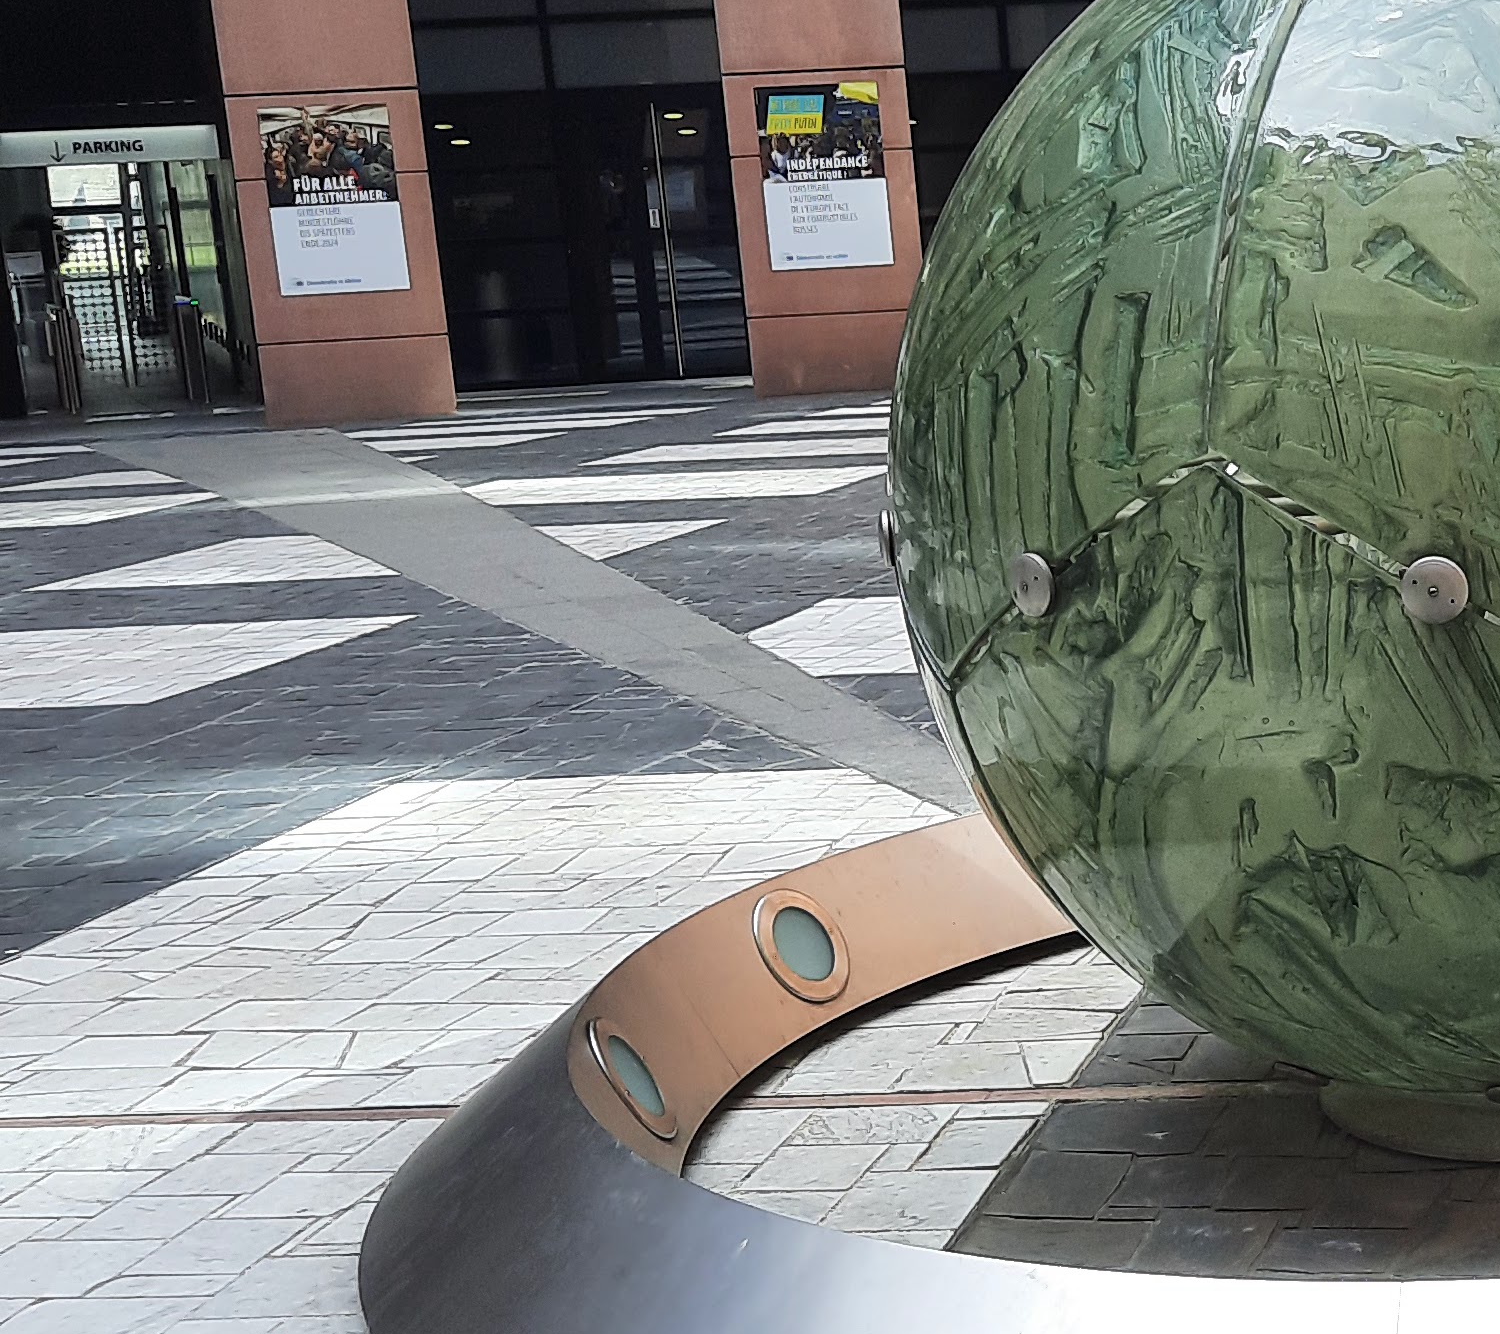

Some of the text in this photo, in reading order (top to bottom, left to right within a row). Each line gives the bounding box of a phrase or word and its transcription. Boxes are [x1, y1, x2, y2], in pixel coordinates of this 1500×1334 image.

[72, 139, 144, 154] PARKING
[293, 174, 357, 192] FÜR ALLE
